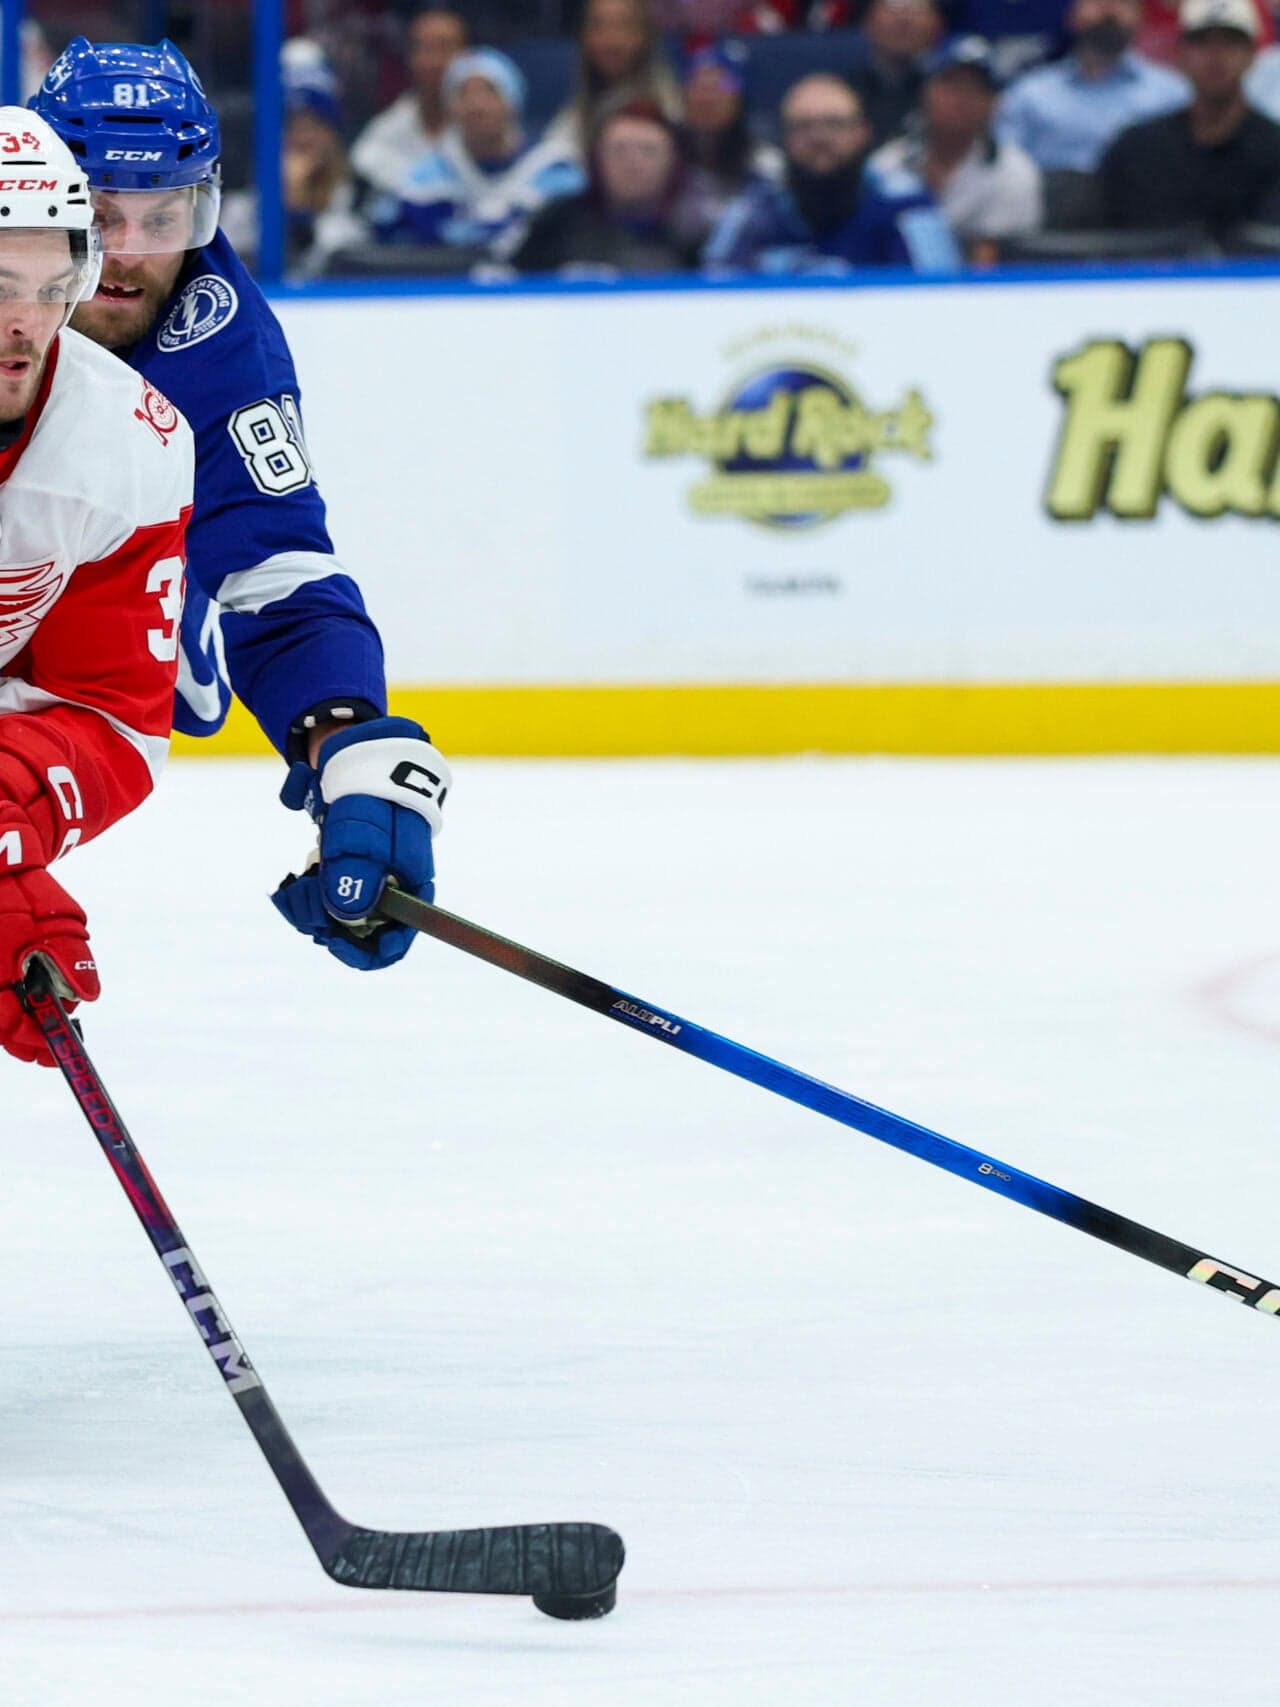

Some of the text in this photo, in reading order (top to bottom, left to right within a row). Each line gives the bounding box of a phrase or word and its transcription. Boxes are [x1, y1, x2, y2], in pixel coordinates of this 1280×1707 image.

[113, 83, 150, 107] 81
[104, 149, 163, 162] CCM
[1046, 336, 1280, 520] Ha
[145, 555, 187, 662] 3
[337, 876, 363, 904] 81
[27, 992, 115, 1129] JETSPEED
[161, 1246, 263, 1395] CCM
